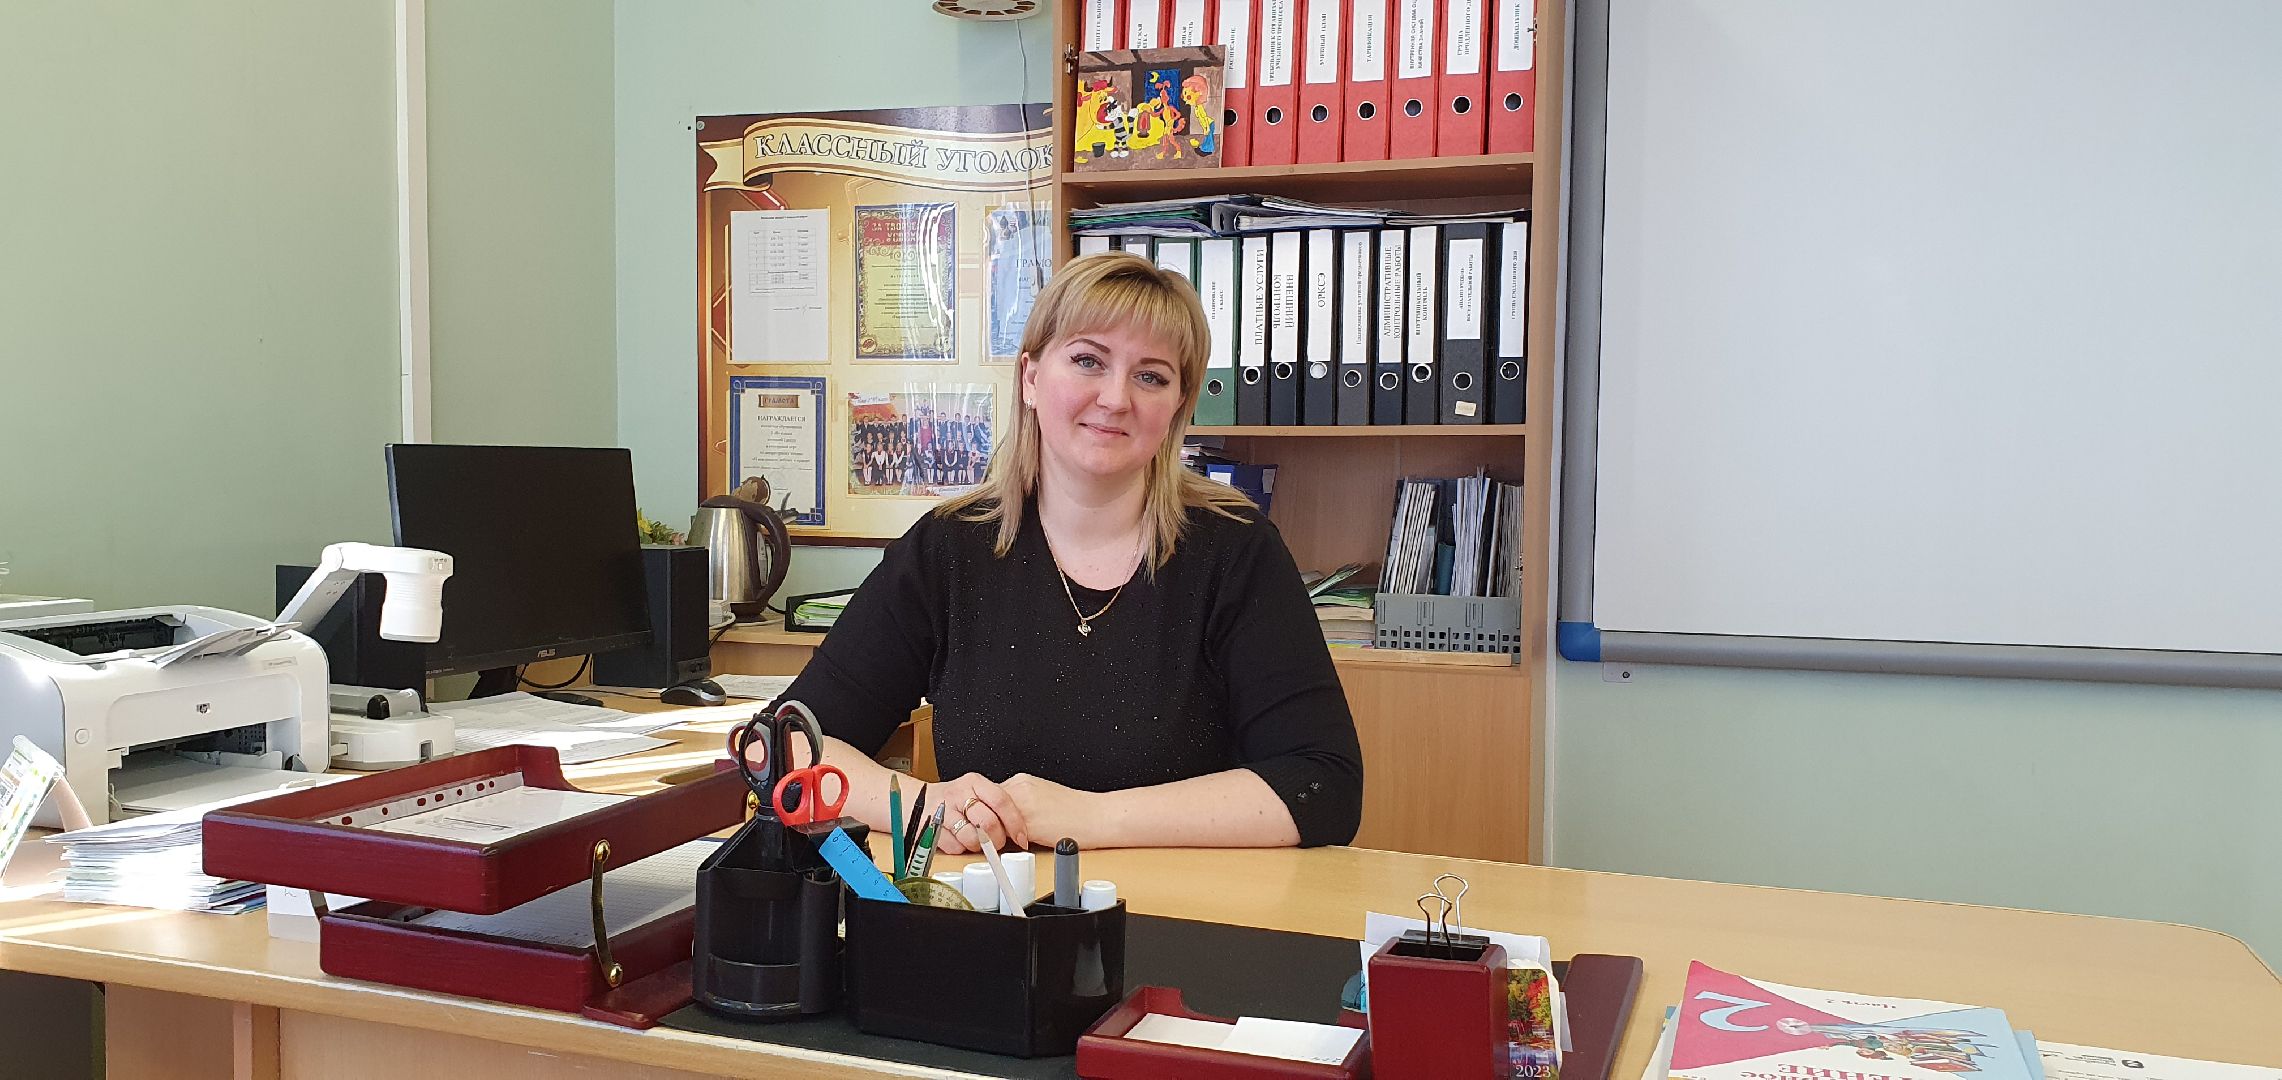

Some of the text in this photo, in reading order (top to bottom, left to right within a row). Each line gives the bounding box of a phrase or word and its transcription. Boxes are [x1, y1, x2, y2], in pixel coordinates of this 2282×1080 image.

[1228, 26, 1236, 70] РАСПИСАНИЕ
[1319, 34, 1327, 66] УЧЕБНЫЙ
[1366, 14, 1374, 63] ТАРИФИКАЦИЯ
[754, 132, 1052, 174] КЛАССНЫЙ УГОЛОК
[872, 222, 882, 231] ЗА
[1254, 249, 1265, 345] ПЛАТНЫЕ УСЛУГИ
[1273, 274, 1282, 329] КОНТРОЛЬ
[1284, 274, 1295, 328] ВНЕШНИЙ
[1317, 273, 1326, 308] ОРКСЭ
[1383, 246, 1393, 337] АДМИНИСТРАТИВНЫЕ
[1393, 244, 1402, 339] КОНТРОЛЬНЫЕ РАБОТЫ
[757, 415, 806, 423] НАГРАЖДАЕТСЯ
[763, 397, 795, 405] ГРАМОТА
[537, 649, 556, 658] ASUS
[1693, 990, 1772, 1031] 2
[1841, 1000, 1897, 1009] Часть
[1515, 1065, 1551, 1078] 2023
